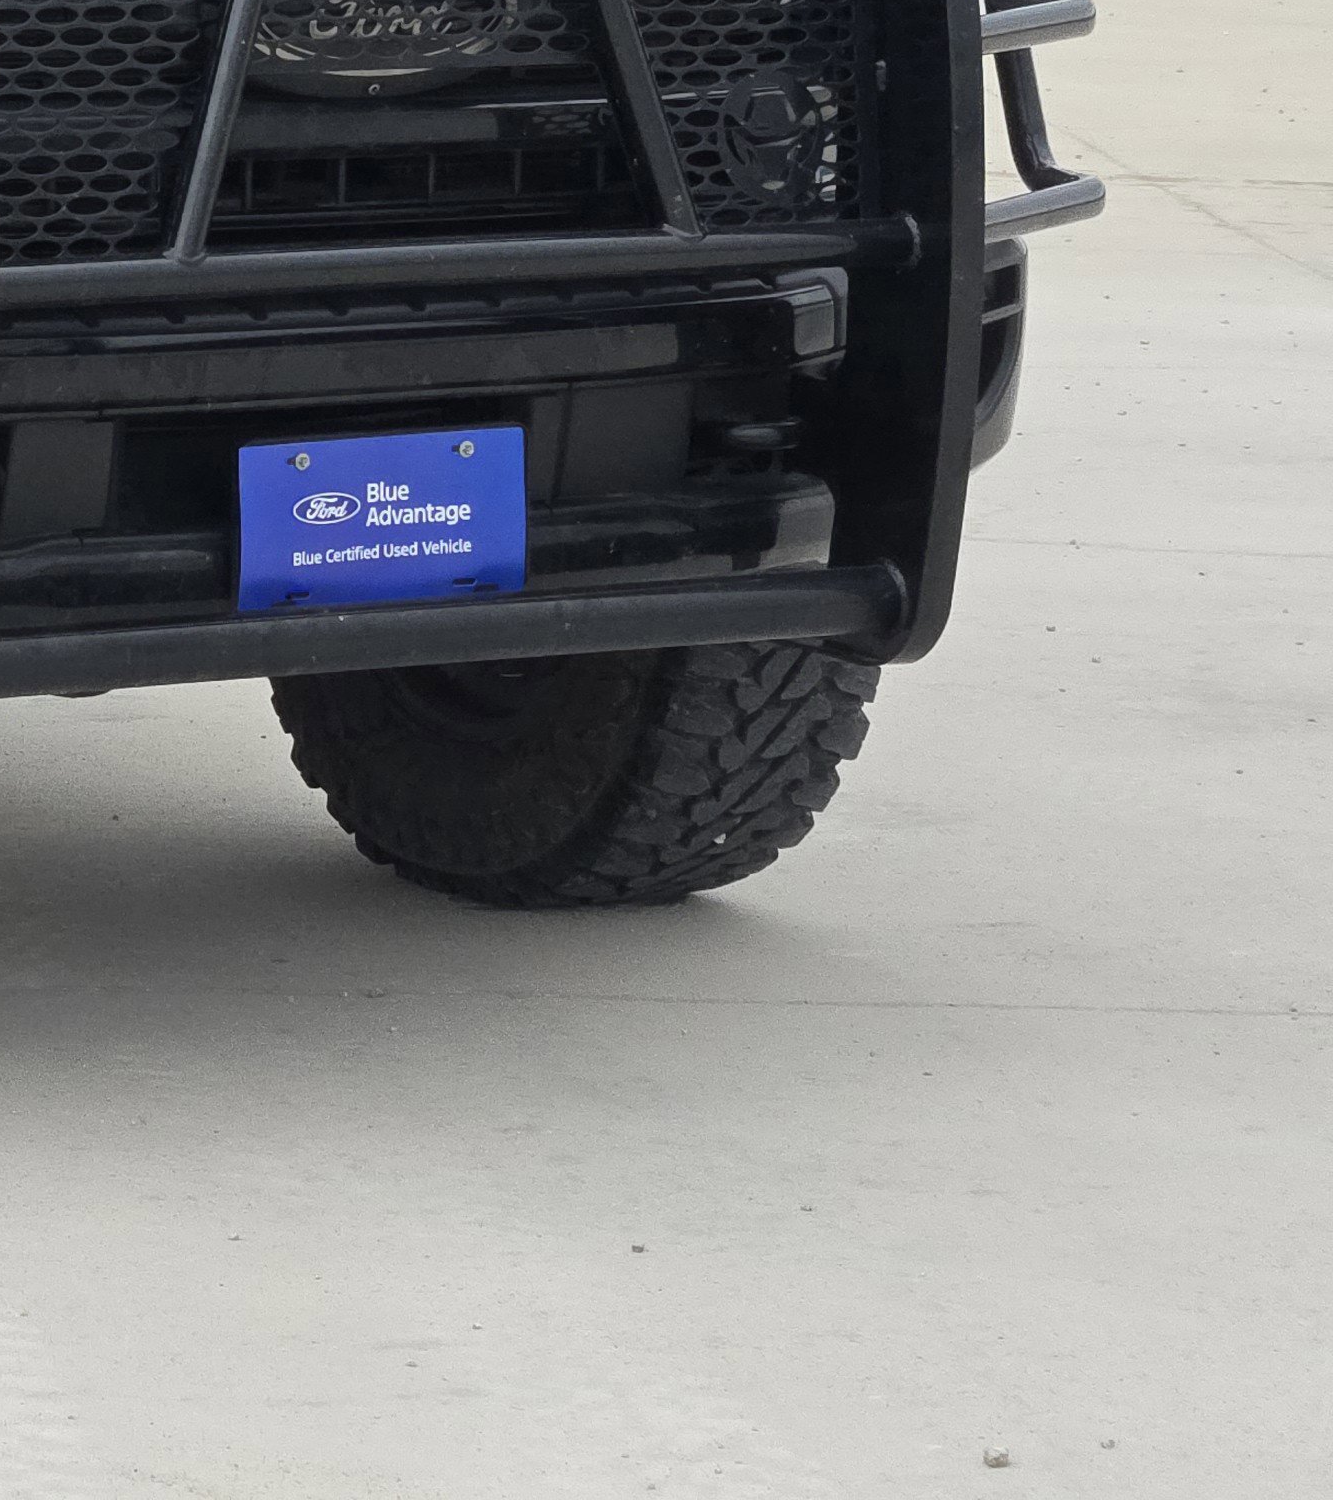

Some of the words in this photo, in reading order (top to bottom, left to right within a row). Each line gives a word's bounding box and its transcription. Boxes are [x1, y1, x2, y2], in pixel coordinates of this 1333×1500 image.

[306, 497, 348, 519] Ford
[366, 481, 409, 503] Blue
[366, 502, 471, 527] Advantage
[293, 551, 322, 566] Blue
[325, 544, 380, 563] Certified
[383, 541, 418, 558] Used
[421, 538, 472, 555] Vehicle
